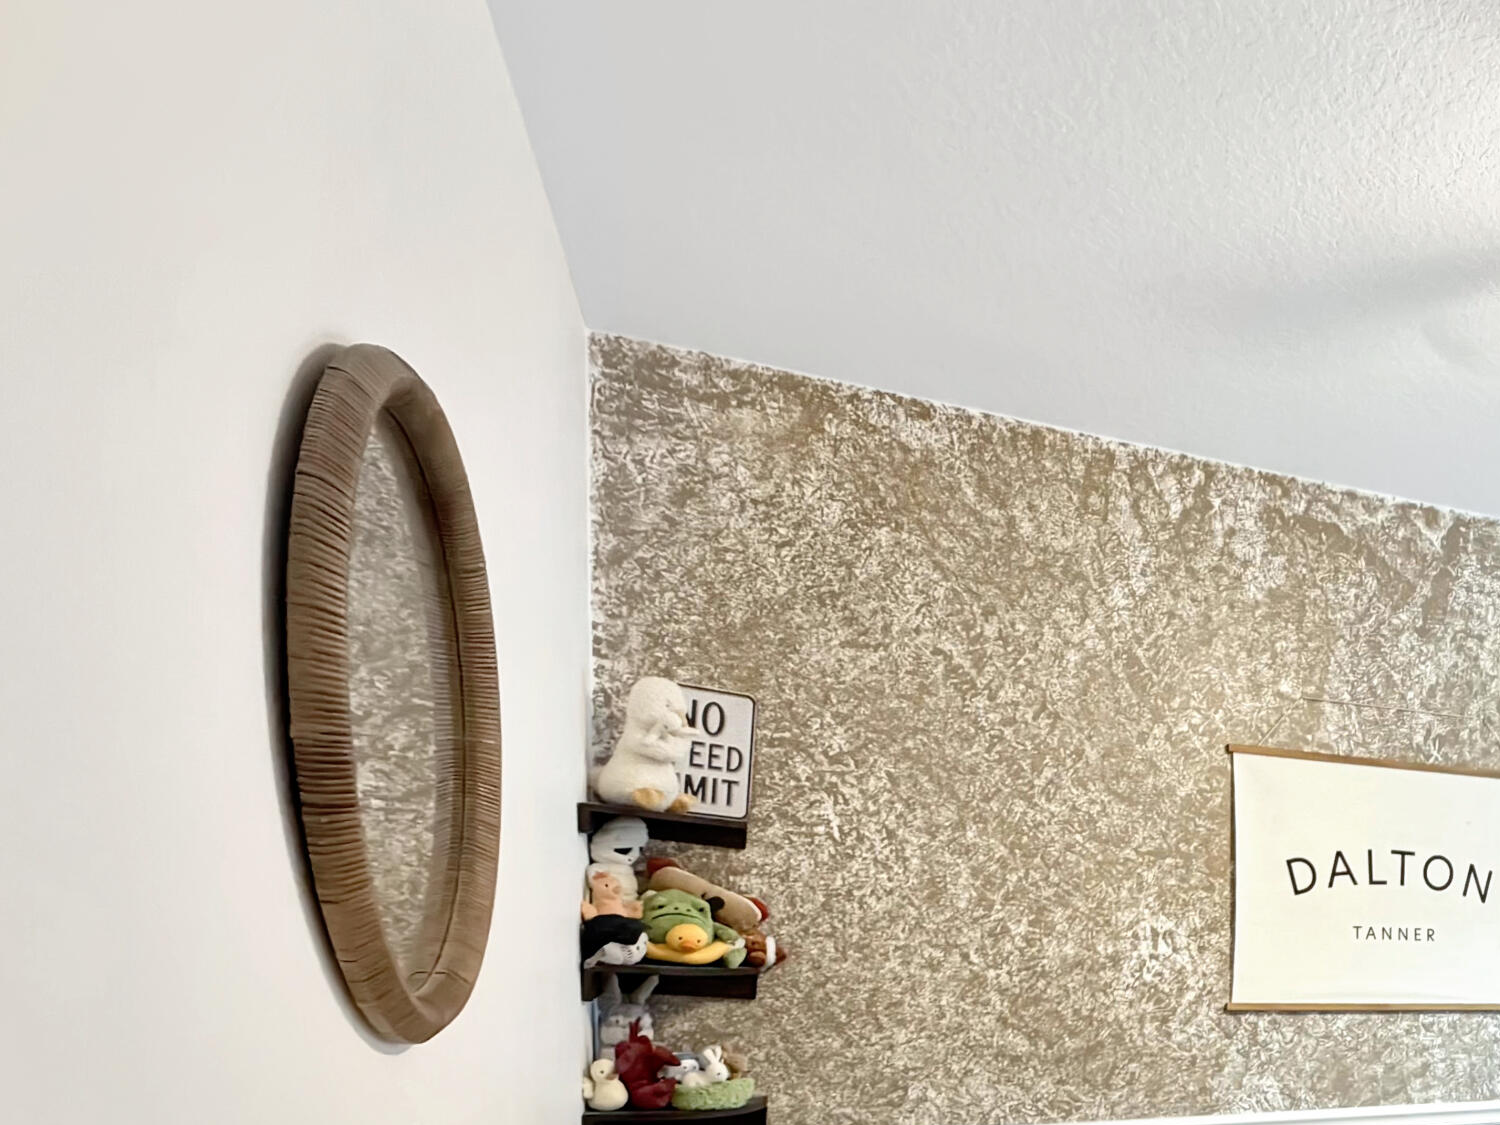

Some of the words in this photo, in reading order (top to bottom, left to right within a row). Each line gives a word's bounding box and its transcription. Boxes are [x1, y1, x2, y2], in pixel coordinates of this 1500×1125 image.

[689, 740, 743, 772] EED
[677, 772, 739, 807] MIT
[1285, 848, 1493, 904] DALTON
[1352, 925, 1436, 942] TANNER
